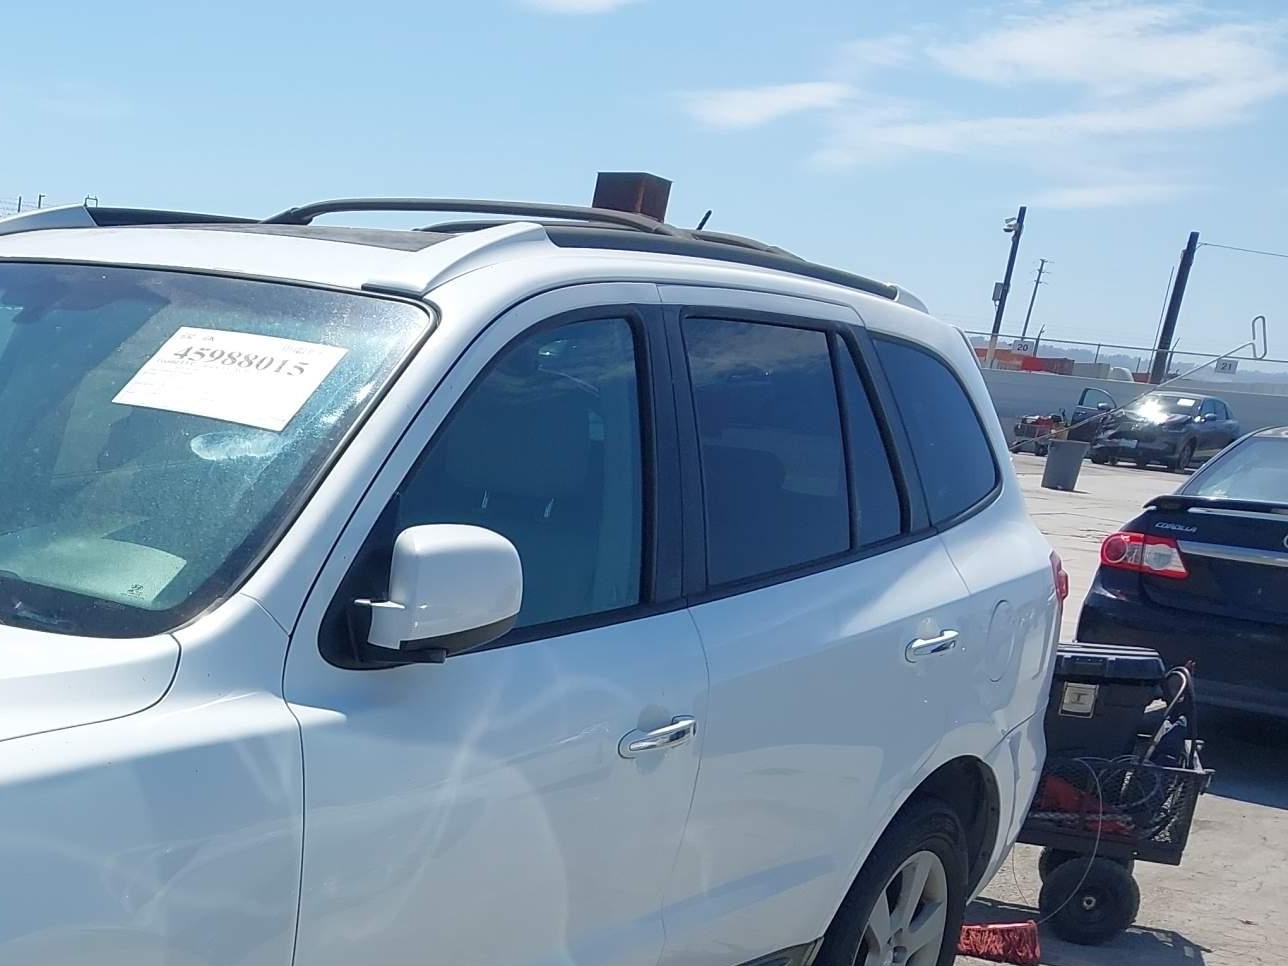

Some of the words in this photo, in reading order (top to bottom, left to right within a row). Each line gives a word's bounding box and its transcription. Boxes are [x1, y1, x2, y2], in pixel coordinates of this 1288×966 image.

[1017, 344, 1029, 352] 20
[172, 345, 310, 377] 45988015
[1221, 362, 1232, 371] 21
[1155, 521, 1197, 532] COROLLA
